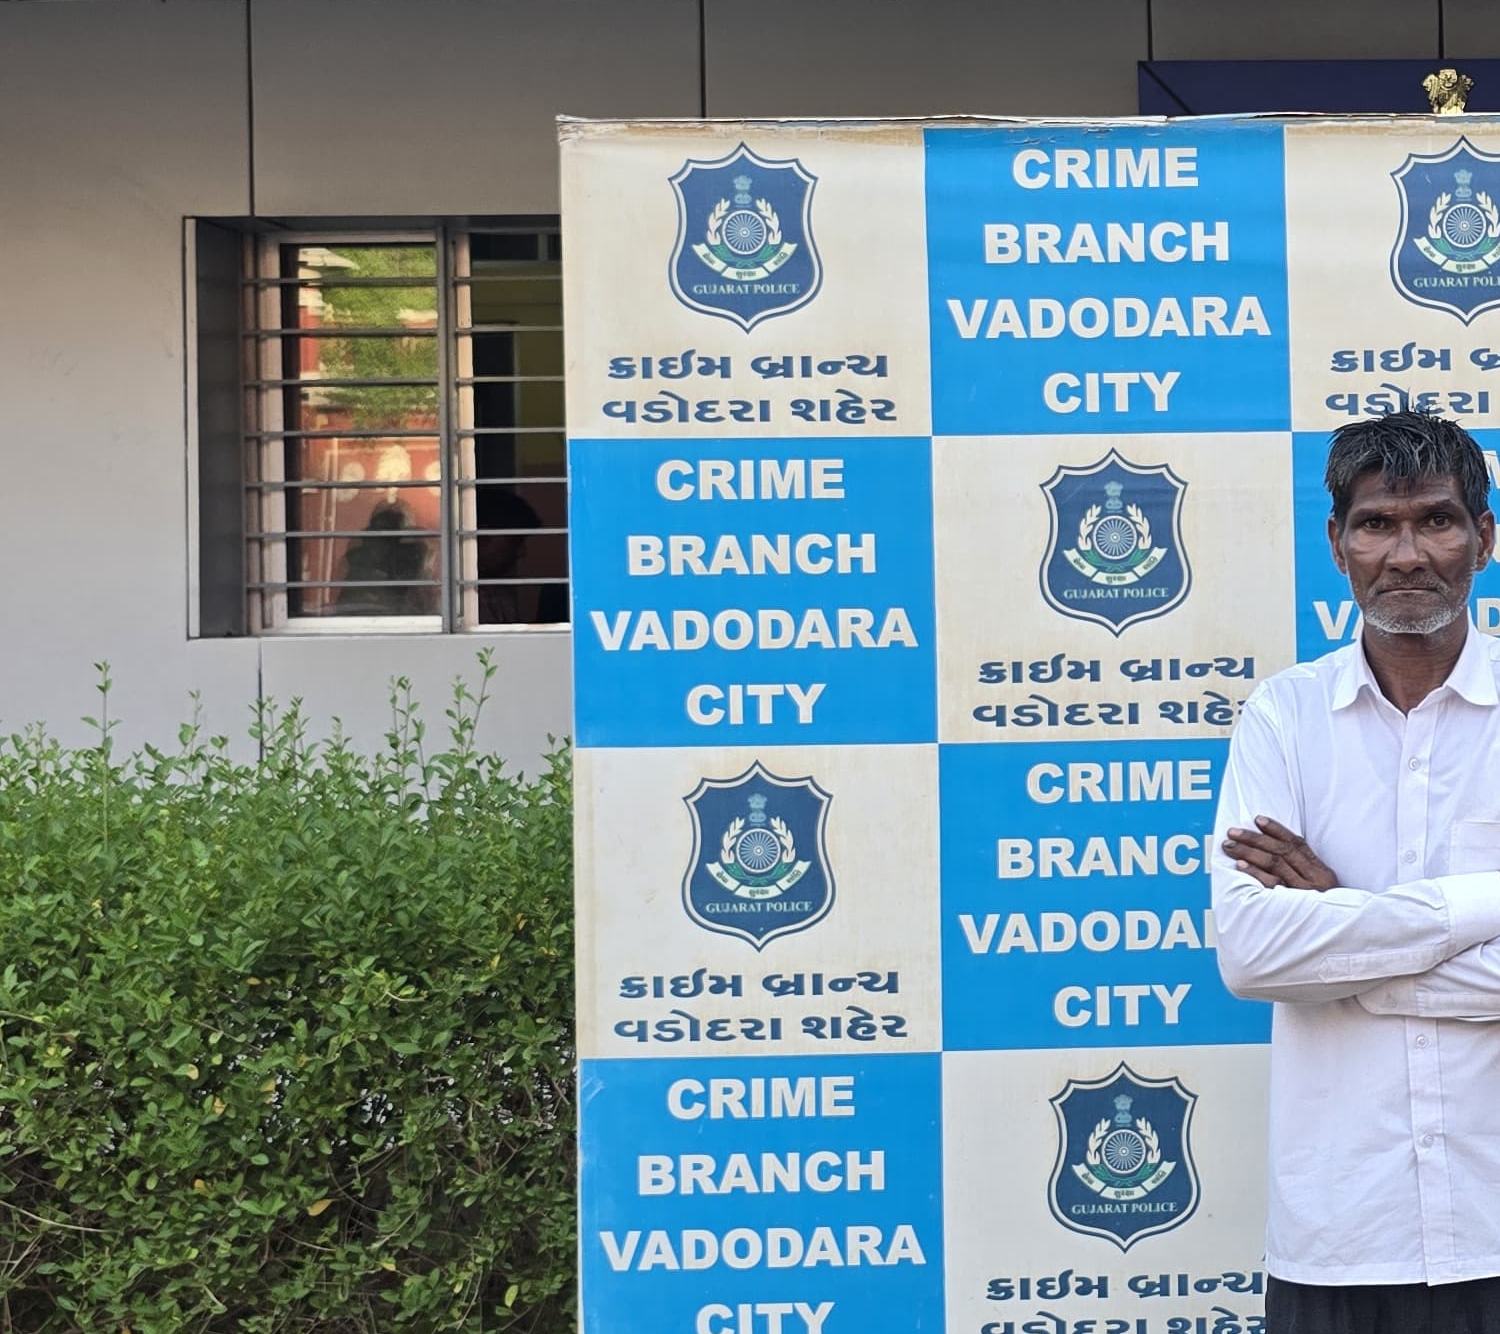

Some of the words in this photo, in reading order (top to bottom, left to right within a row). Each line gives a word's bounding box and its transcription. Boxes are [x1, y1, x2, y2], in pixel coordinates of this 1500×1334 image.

[1012, 147, 1199, 190] CRIME
[984, 221, 1229, 264] BRANCH
[692, 283, 750, 295] GUJARAT
[753, 283, 799, 294] POLICE
[1413, 276, 1469, 288] GUJARAT
[947, 295, 1271, 339] VADODARA
[608, 349, 731, 380] ક્રાઈમ
[750, 354, 888, 380] બ્રાન્ચ
[1331, 341, 1451, 373] ક્રાઈમ
[602, 390, 770, 423] વડોદરા
[790, 388, 896, 425] શહેર
[1043, 371, 1181, 414] CITY
[1325, 383, 1489, 417] વડોદરા
[656, 458, 845, 501] CRIME
[627, 533, 876, 576] BRANCH
[1063, 588, 1119, 599] GUJARAT
[1123, 587, 1169, 599] POLICE
[590, 607, 918, 651] VADODARA
[978, 653, 1101, 684] ક્રાઈમ
[1119, 657, 1255, 683] બ્રાન્ચ
[686, 683, 826, 726] CITY
[972, 694, 1139, 728] વડોદરા
[1026, 760, 1212, 804] CRIME
[705, 902, 762, 914] GUJARAT
[766, 901, 812, 912] POLICE
[959, 909, 1216, 954] VADODA
[619, 968, 743, 999] ક્રાઈમ
[761, 971, 899, 998] બ્રાન્ચ
[614, 1009, 782, 1043] વડોદરા
[801, 1005, 907, 1042] શહેર
[1053, 983, 1191, 1028] CITY
[667, 1076, 855, 1120] CRIME
[638, 1150, 885, 1196] BRANCH
[1071, 1203, 1129, 1214] GUJARAT
[1131, 1202, 1180, 1213] POLICE
[599, 1224, 926, 1272] VADODARA
[985, 1268, 1109, 1301] ક્રાઈમ
[1127, 1271, 1264, 1299] બ્રાન્ચ
